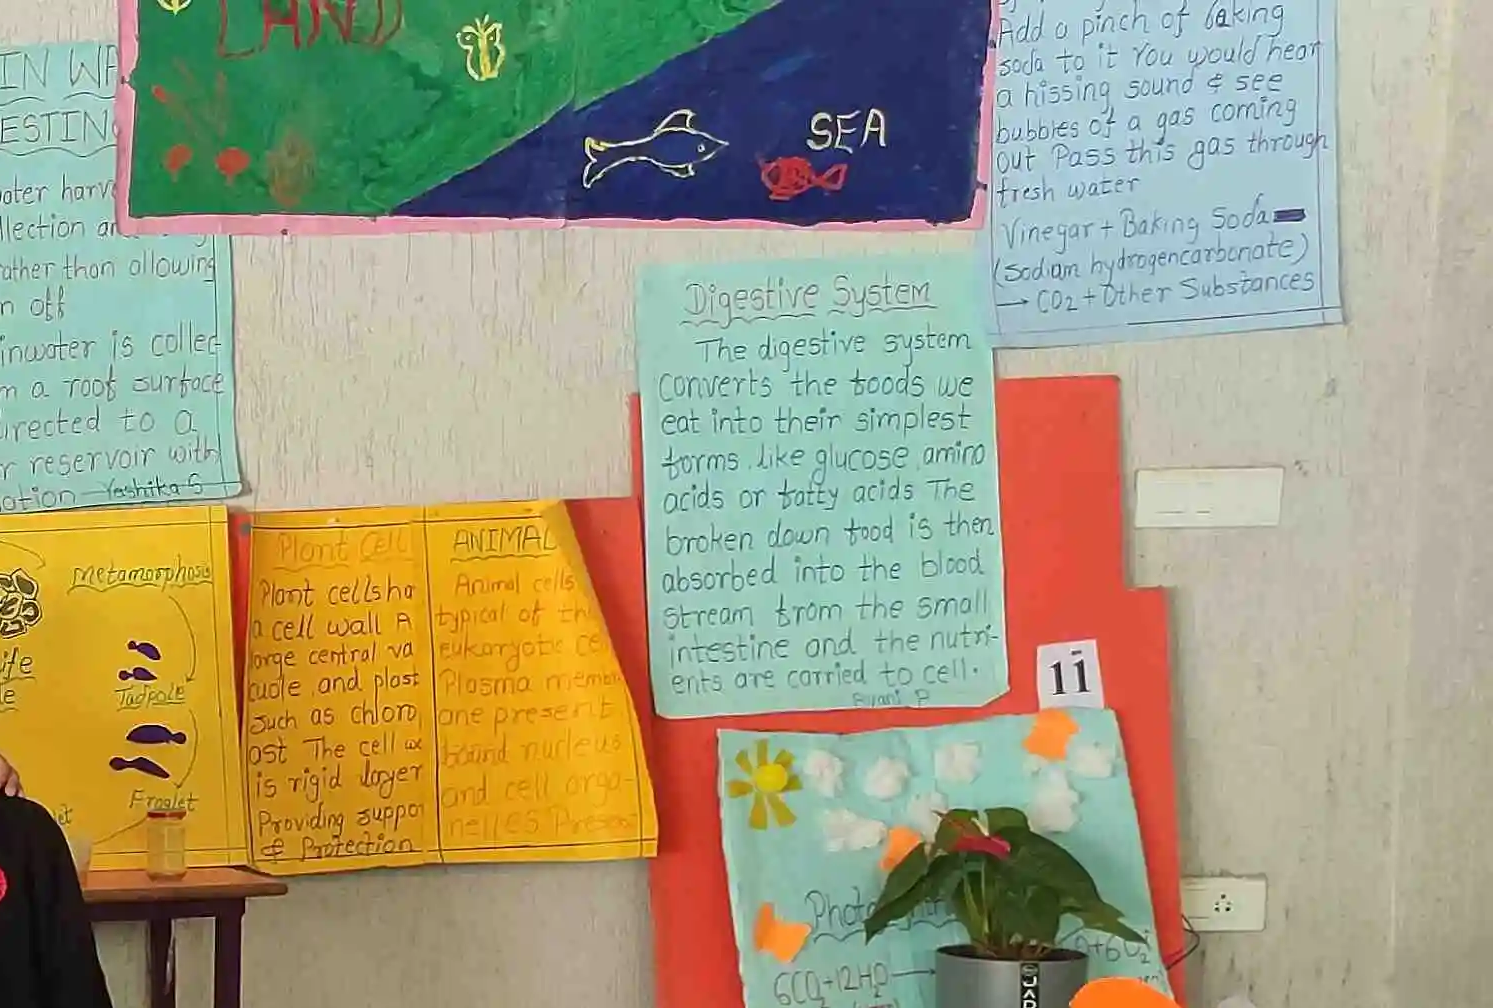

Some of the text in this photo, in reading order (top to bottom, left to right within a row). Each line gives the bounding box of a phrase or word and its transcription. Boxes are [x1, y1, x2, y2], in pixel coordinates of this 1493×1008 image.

[808, 109, 885, 153] SEA
[1002, 222, 1094, 252] Vinegar
[1120, 209, 1199, 237] Baking
[1212, 193, 1269, 230] Soda
[685, 275, 931, 329] Digestive System
[111, 329, 134, 359] is
[696, 330, 971, 371] The digestive system
[123, 406, 155, 432] to
[175, 409, 195, 432] a
[661, 405, 972, 434] eat into their simplest
[279, 529, 408, 562] Plant Cell
[453, 526, 557, 552] ANIMAL
[71, 556, 211, 586] Metamorphosis
[662, 549, 983, 593] absorbed into the blood
[261, 578, 381, 606] Plant cells
[117, 688, 185, 708] Tadpole
[258, 806, 343, 836] Providing
